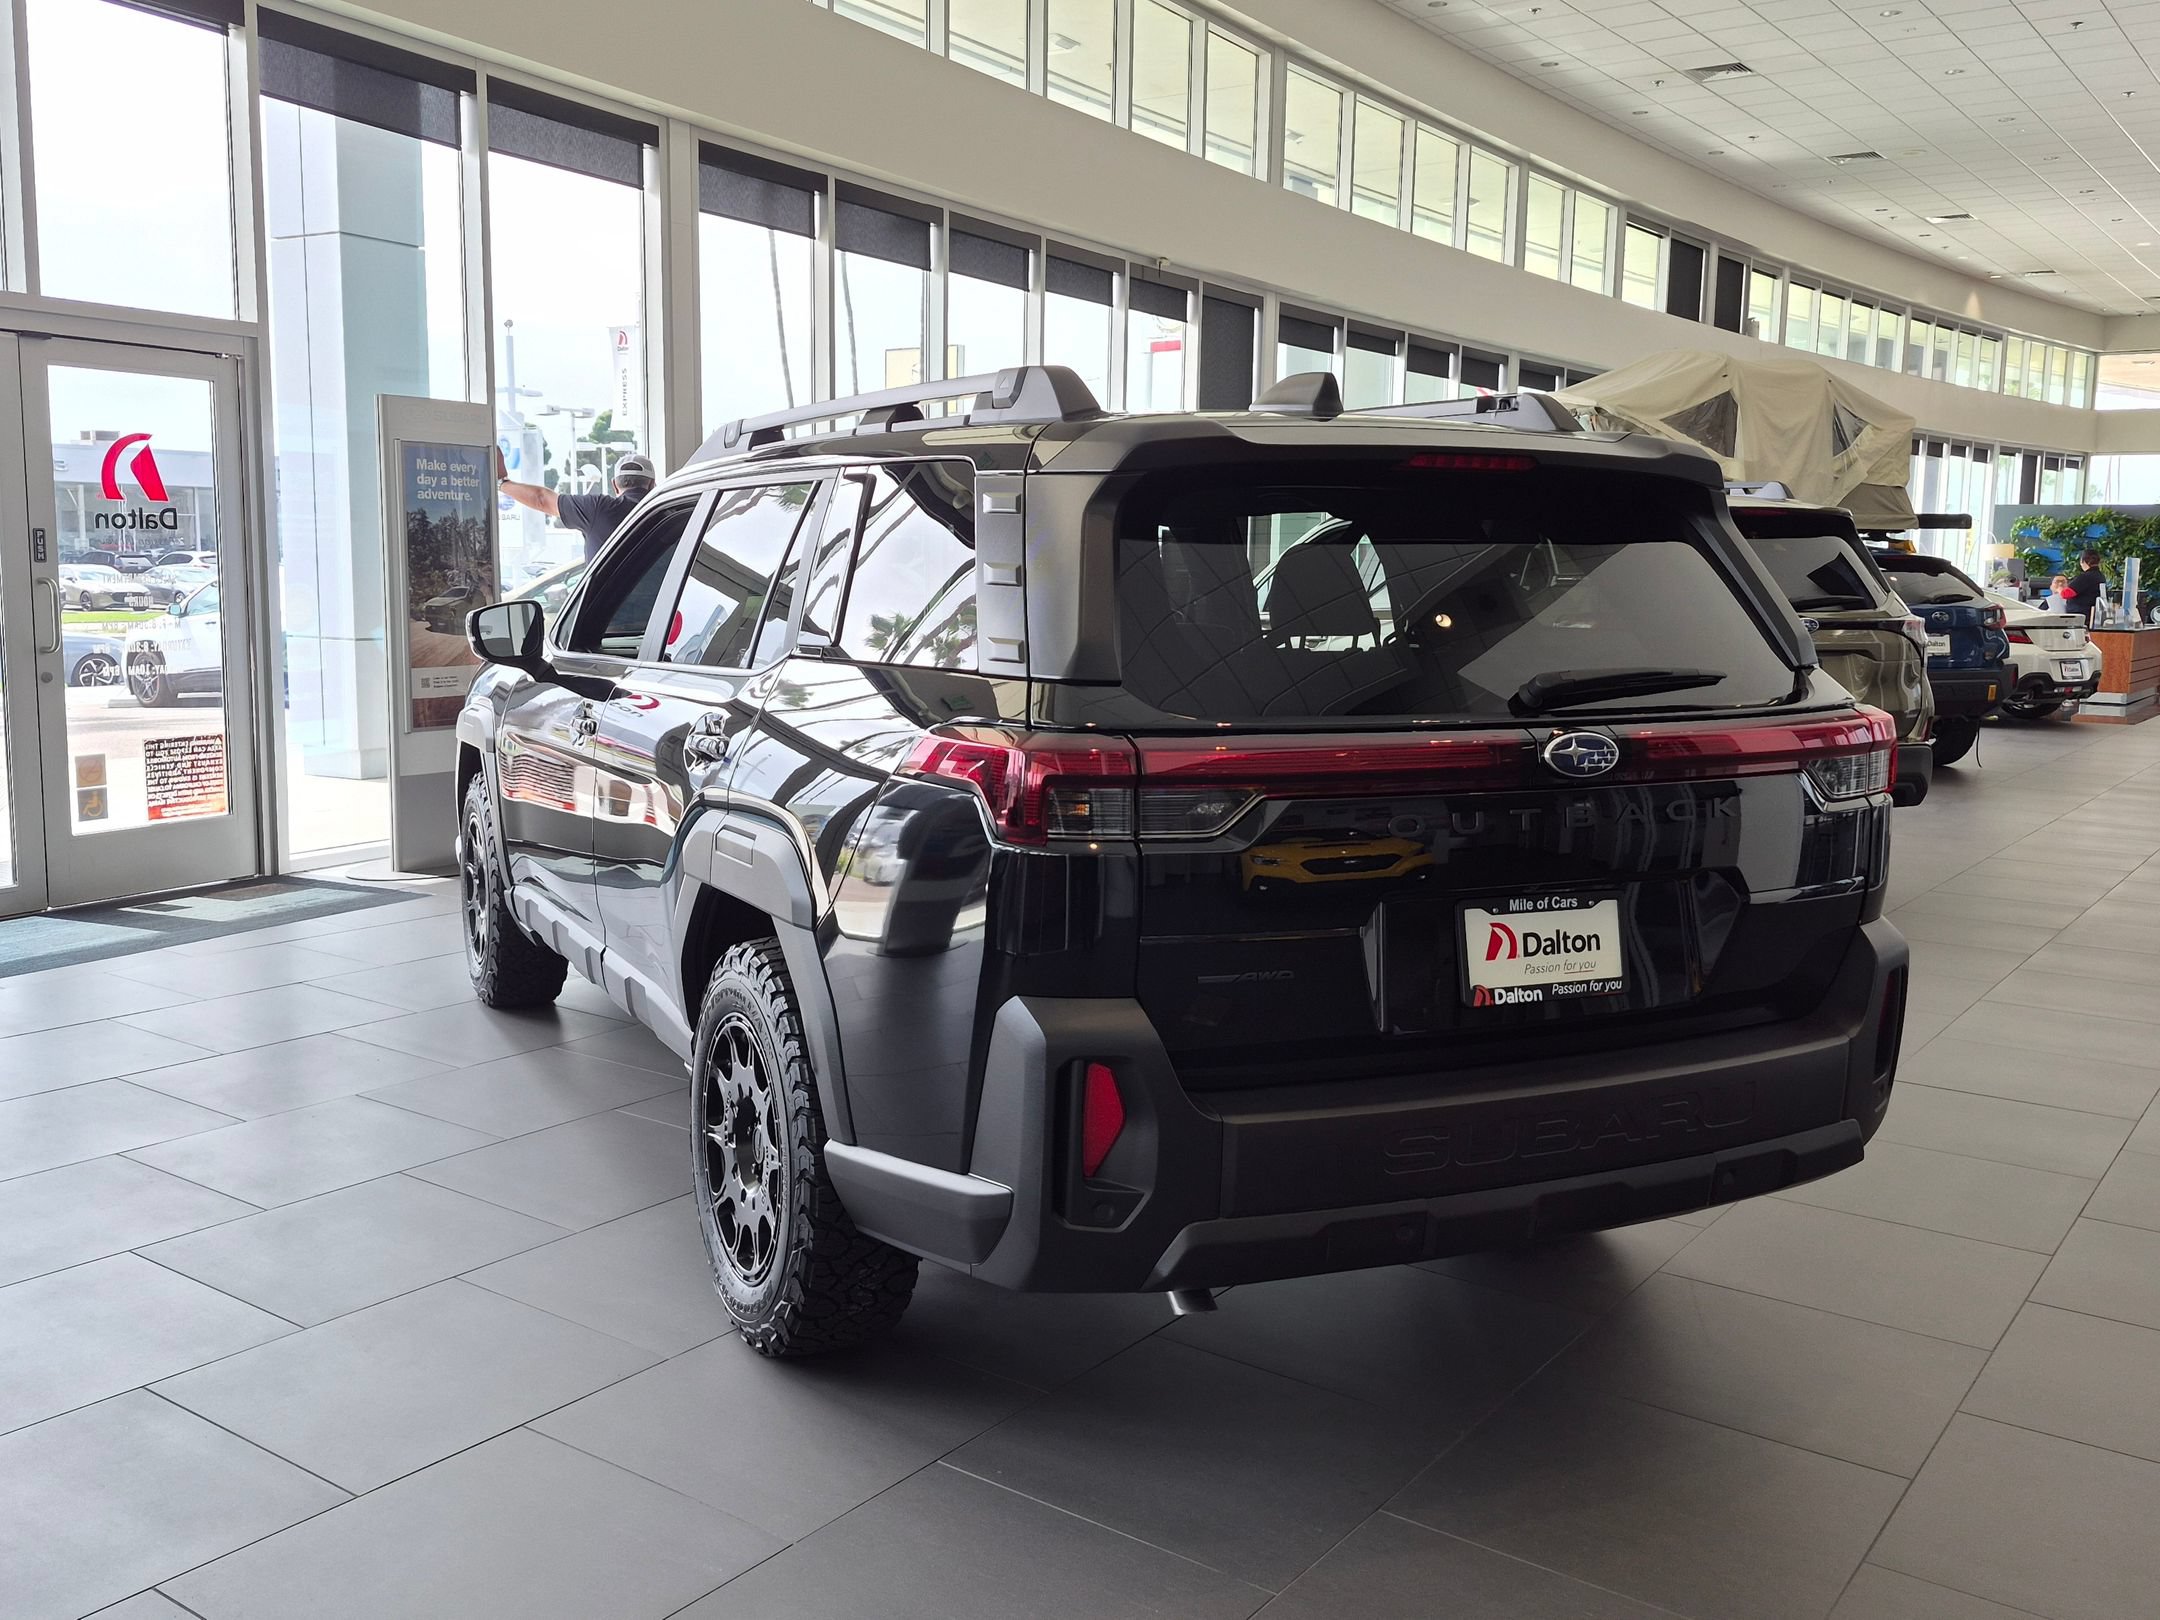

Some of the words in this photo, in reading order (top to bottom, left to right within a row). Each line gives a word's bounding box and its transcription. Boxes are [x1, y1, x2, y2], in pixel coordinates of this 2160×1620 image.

[416, 458, 447, 471] Make
[450, 463, 476, 475] every
[416, 473, 437, 487] day
[440, 476, 447, 486] a
[450, 475, 480, 487] better
[417, 488, 472, 501] adventure.
[36, 530, 44, 560] PUSH
[1387, 796, 1739, 838] OUTBACK
[1509, 899, 1534, 912] Mile
[1536, 897, 1549, 909] of
[1551, 896, 1578, 909] Cars
[1522, 929, 1601, 958] Dalton
[1524, 963, 1561, 975] Passion
[1562, 959, 1577, 974] for
[1578, 961, 1597, 973] you
[1494, 988, 1544, 1005] Dalton
[1551, 982, 1588, 995] Passion
[1589, 980, 1603, 994] for
[1604, 980, 1623, 993] you
[1383, 1080, 1758, 1176] SUBARU
